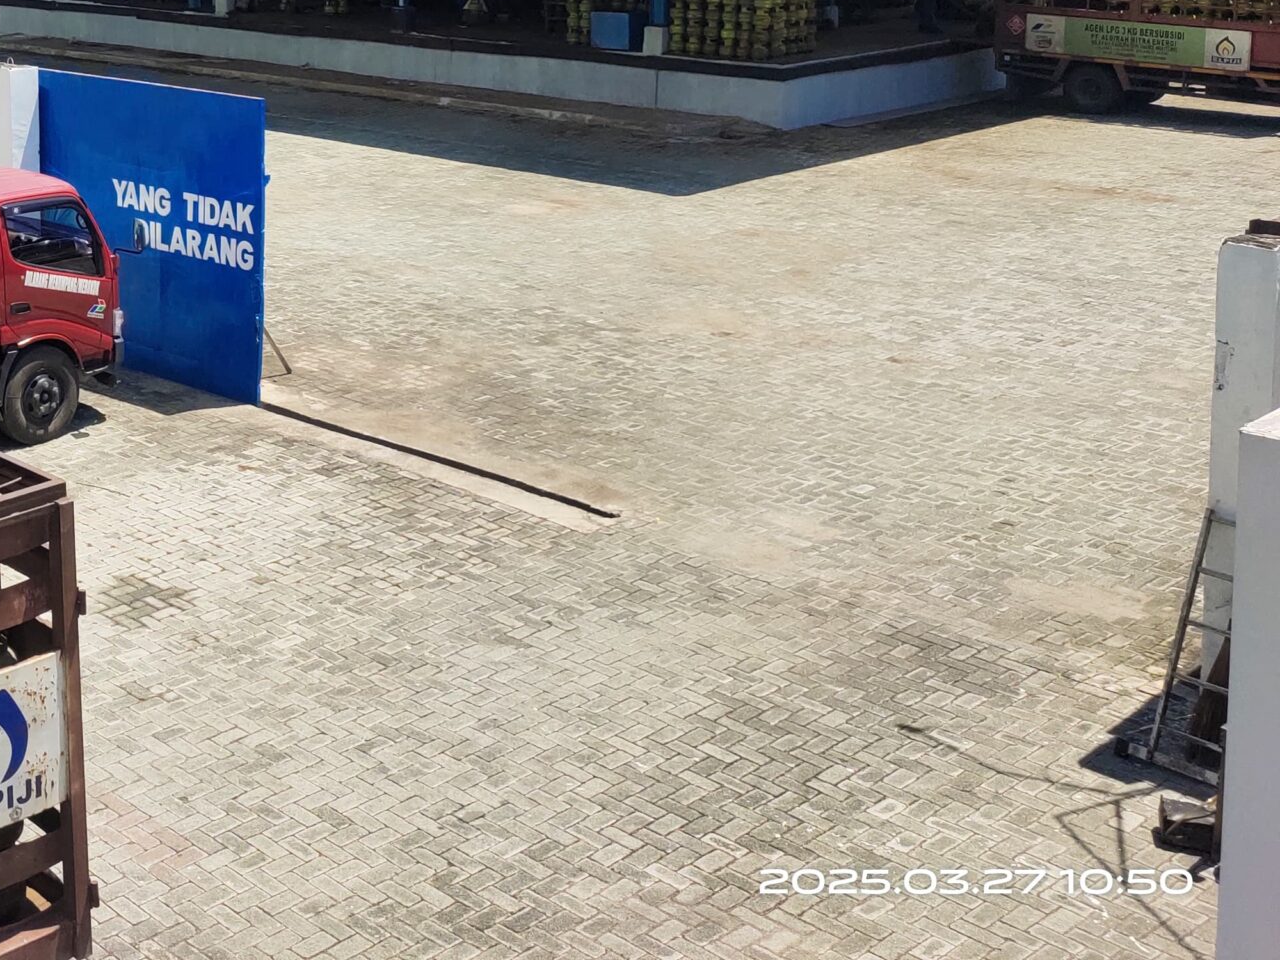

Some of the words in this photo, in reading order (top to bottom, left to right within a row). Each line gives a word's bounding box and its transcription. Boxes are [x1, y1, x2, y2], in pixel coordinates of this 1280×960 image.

[1139, 28, 1185, 40] BERSUBSIDI
[112, 178, 171, 217] YANG
[183, 192, 254, 235] TIDAK
